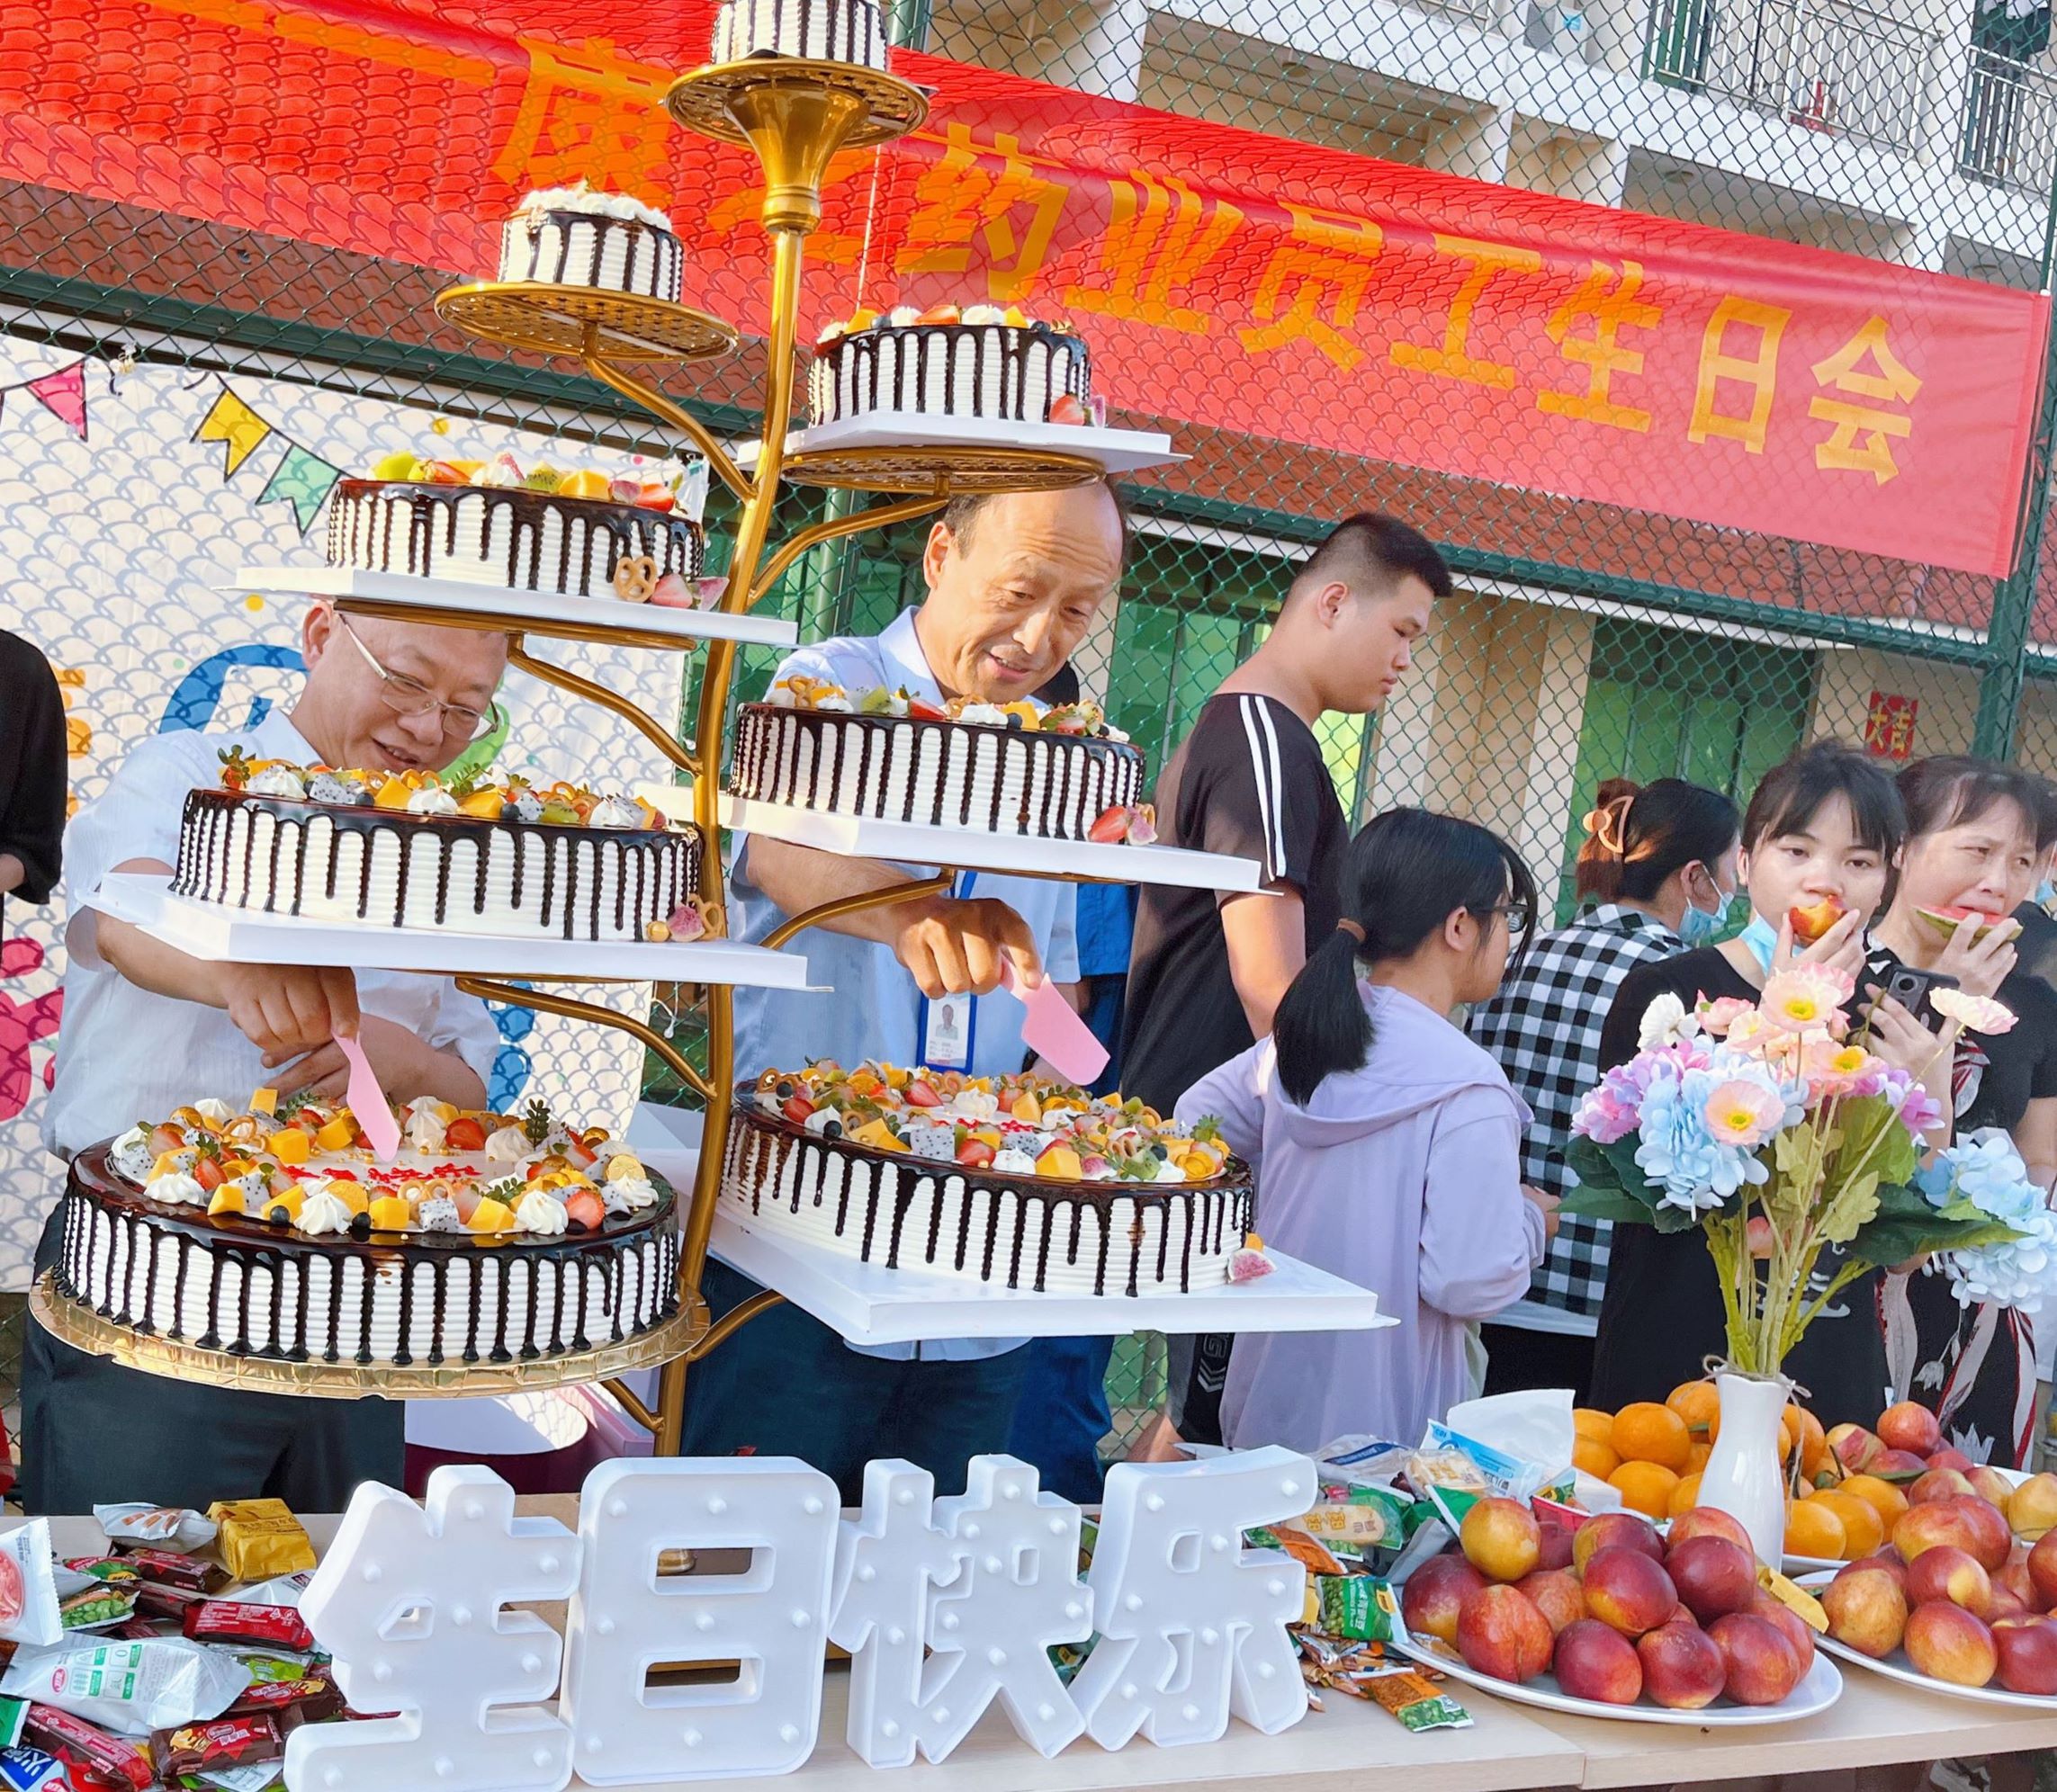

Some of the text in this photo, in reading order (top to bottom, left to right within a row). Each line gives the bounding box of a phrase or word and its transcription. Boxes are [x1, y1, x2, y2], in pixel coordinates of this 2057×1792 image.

[1865, 703, 1912, 751] 大吉
[284, 1444, 1318, 1792] 生日快乐
